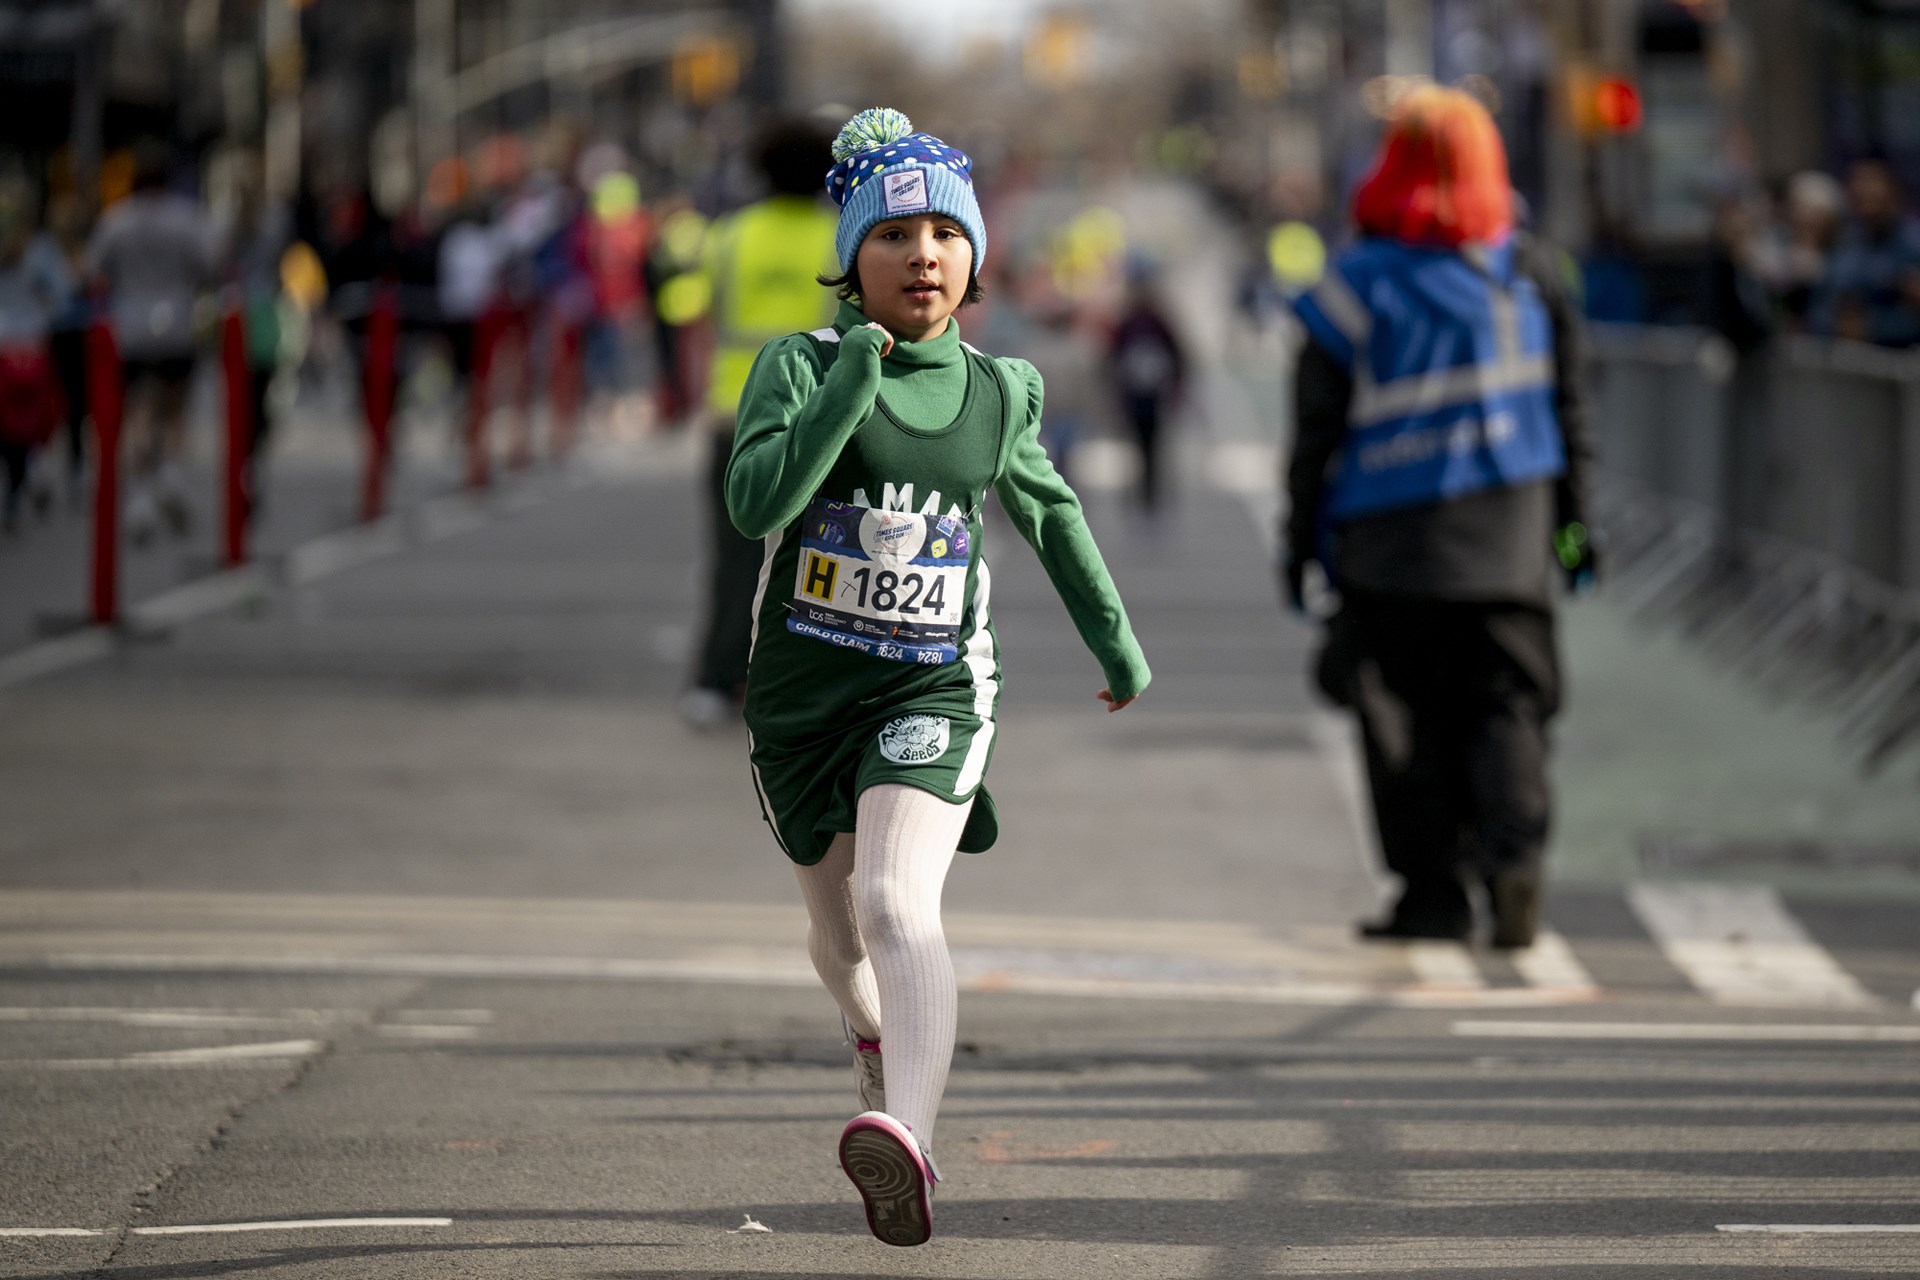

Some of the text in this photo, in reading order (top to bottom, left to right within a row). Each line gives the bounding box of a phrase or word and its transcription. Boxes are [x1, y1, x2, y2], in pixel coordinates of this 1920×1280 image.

[876, 522, 914, 538] TIMES SQUARE
[806, 555, 836, 599] H
[853, 567, 945, 616] 1824
[795, 622, 871, 652] CHILD CLAIM
[876, 645, 904, 660] 1824
[917, 650, 943, 664] 1824
